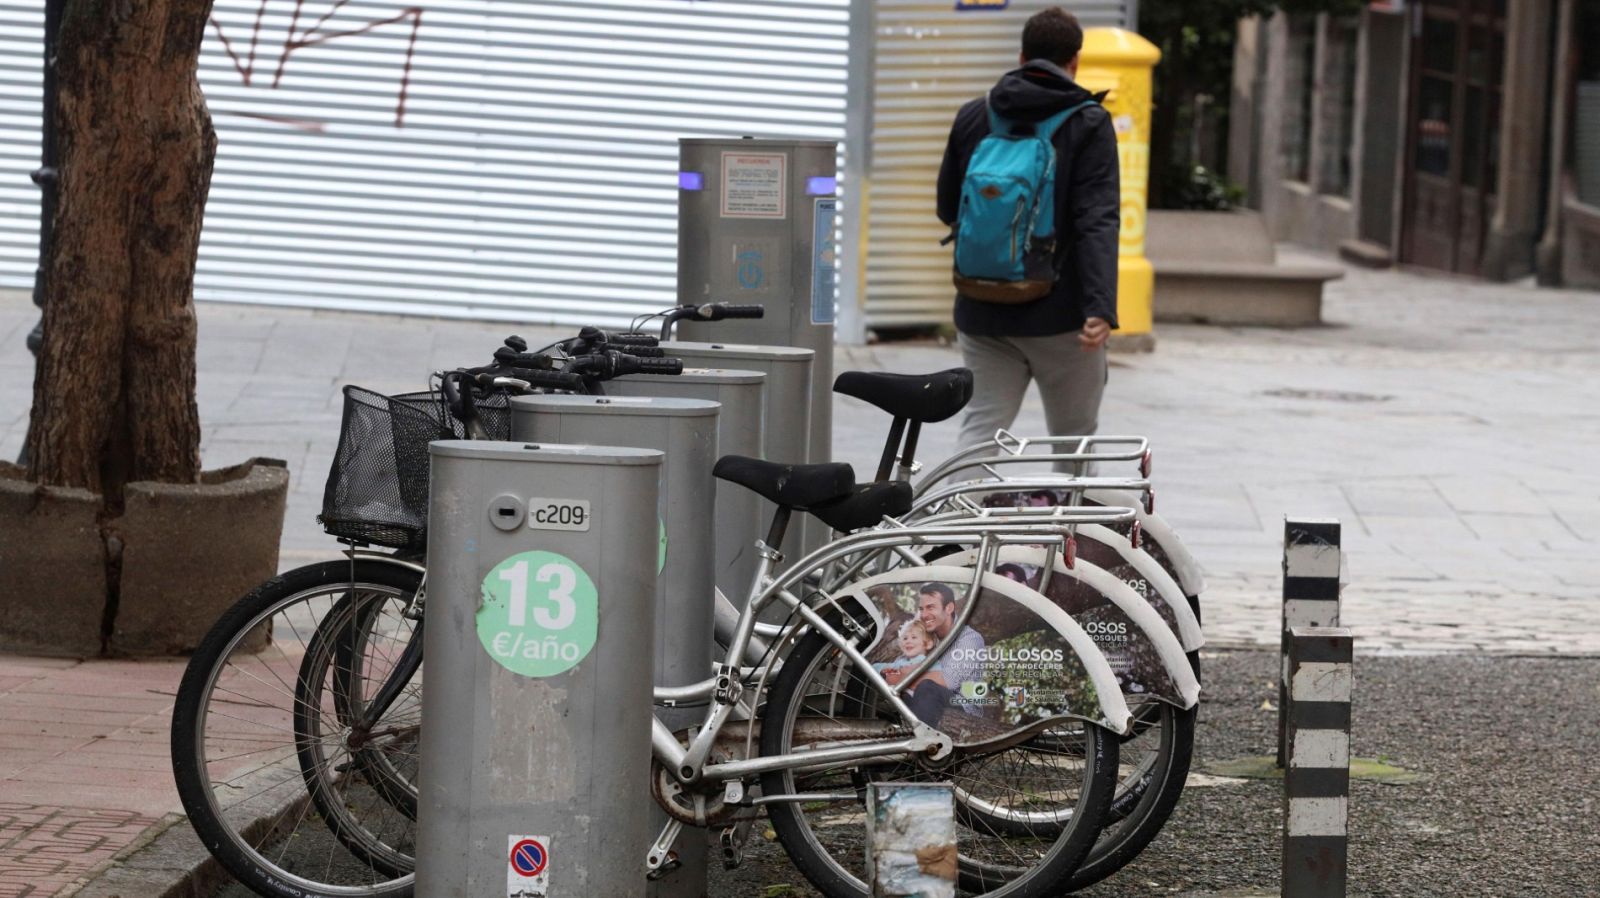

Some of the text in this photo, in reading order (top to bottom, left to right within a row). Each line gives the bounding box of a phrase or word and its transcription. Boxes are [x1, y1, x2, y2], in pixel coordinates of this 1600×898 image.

[536, 504, 585, 525] c209
[499, 560, 577, 630] 13
[492, 631, 580, 662] €/año
[951, 648, 1064, 662] ORGULLOSOS
[1007, 662, 1064, 670] ATARDECERES
[951, 698, 998, 706] ECOEMBES
